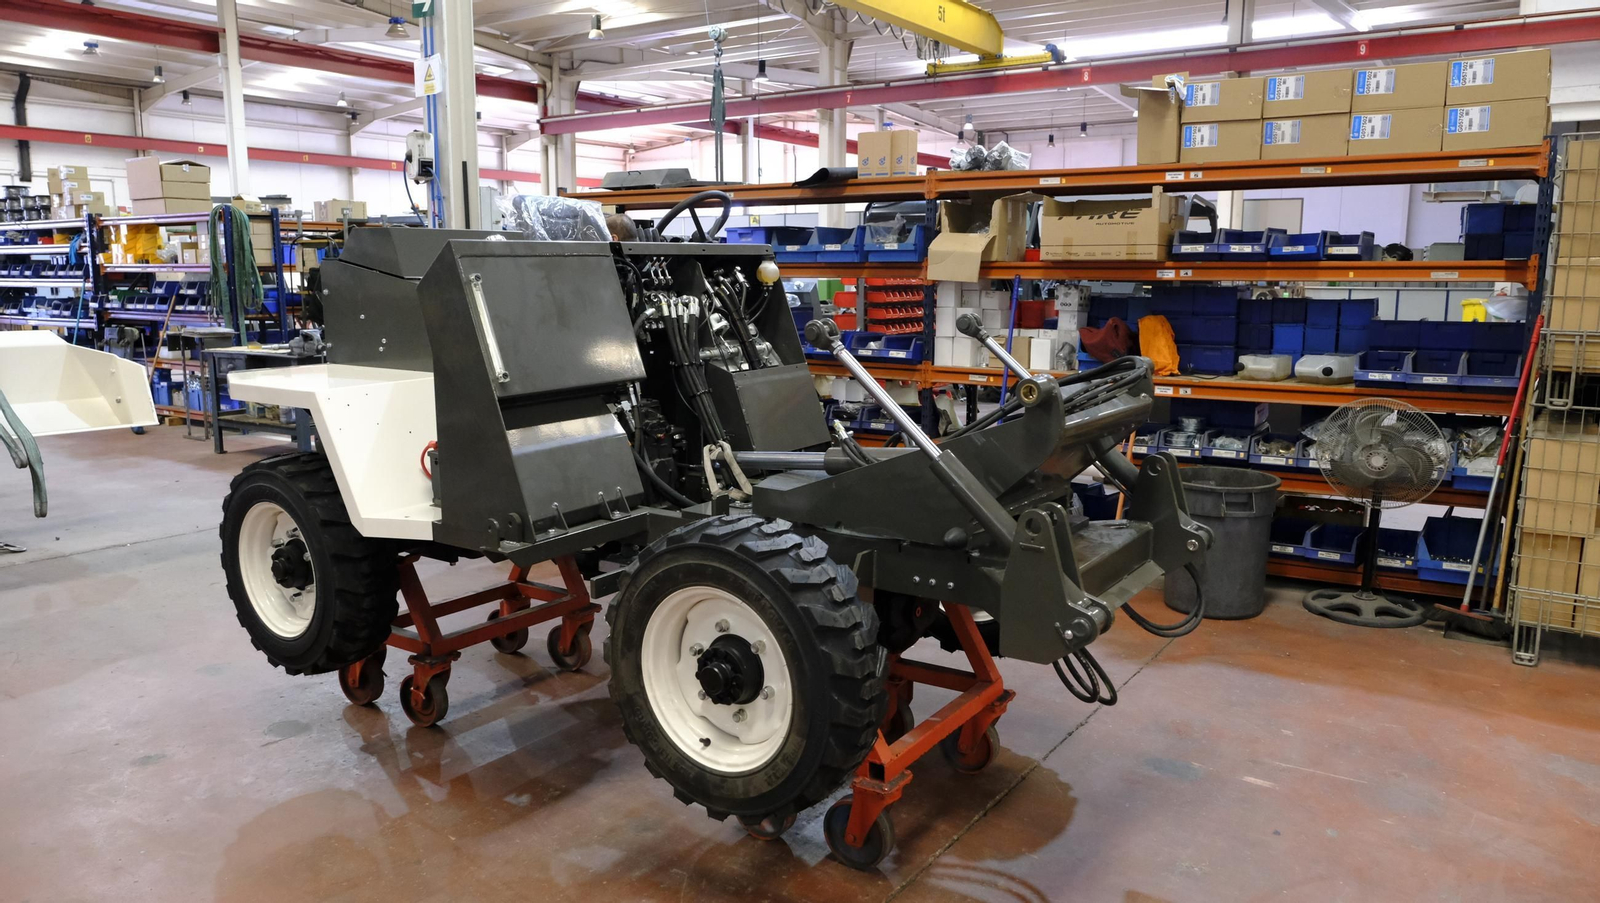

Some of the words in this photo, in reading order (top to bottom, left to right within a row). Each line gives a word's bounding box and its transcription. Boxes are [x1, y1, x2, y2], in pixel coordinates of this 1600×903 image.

[1360, 43, 1366, 56] 9
[1083, 71, 1089, 82] 8
[846, 94, 851, 104] 7
